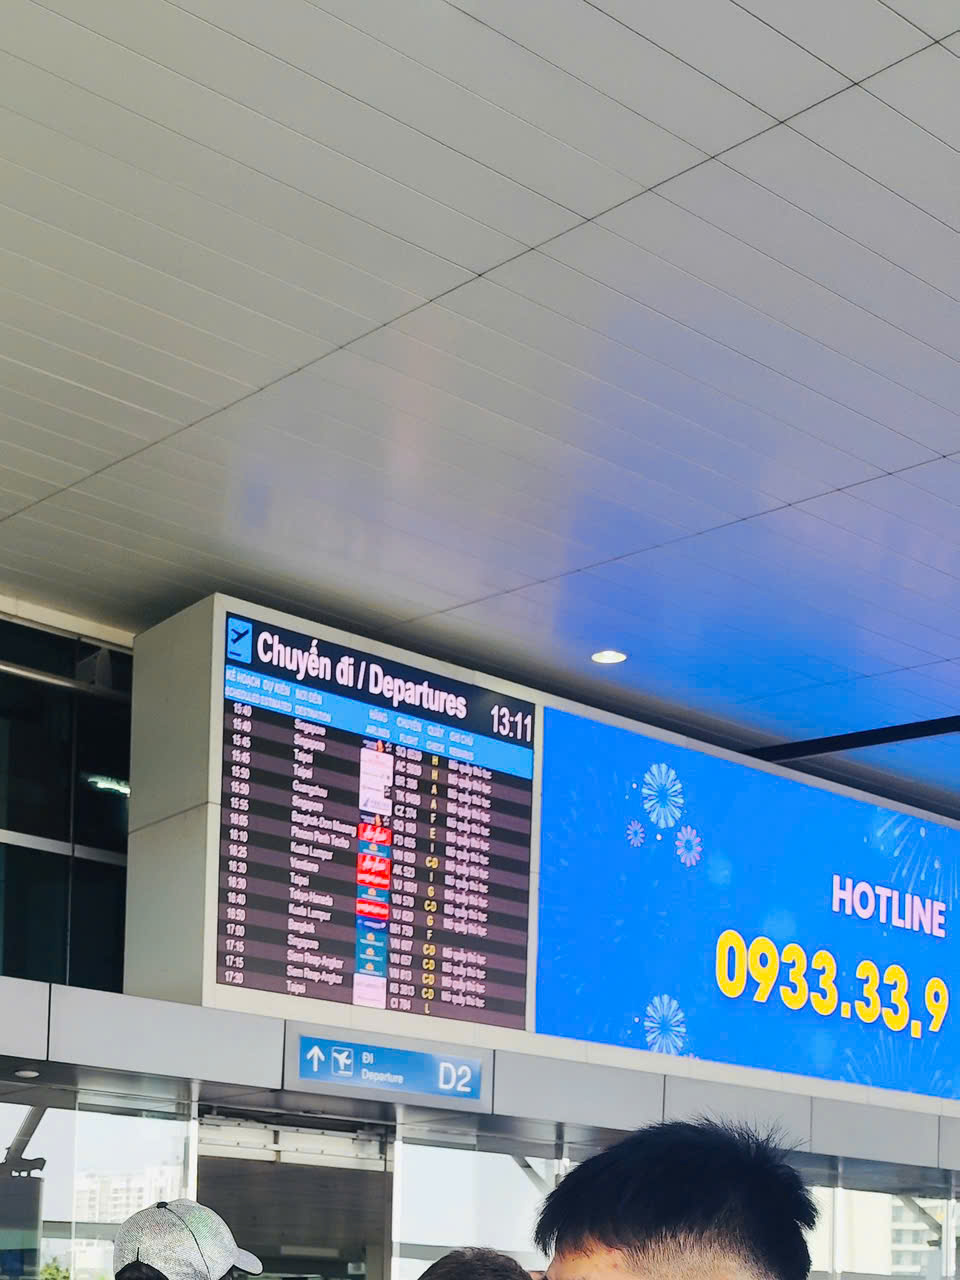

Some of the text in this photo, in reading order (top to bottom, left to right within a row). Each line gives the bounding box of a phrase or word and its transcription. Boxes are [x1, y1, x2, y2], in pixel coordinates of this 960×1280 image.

[257, 631, 332, 681] Chuyến
[336, 656, 355, 688] đi
[368, 663, 468, 719] Departures
[491, 704, 533, 743] 13:11
[432, 785, 436, 794] A
[430, 799, 436, 809] A
[395, 805, 404, 816] CZ
[431, 814, 436, 823] F
[430, 828, 435, 838] E
[832, 874, 947, 939] HOTLINE
[427, 915, 433, 926] G
[427, 930, 432, 939] F
[715, 929, 950, 1039] 0933.33.9
[425, 1003, 430, 1013] L
[361, 1068, 404, 1085] Departure
[438, 1061, 472, 1093] D2
